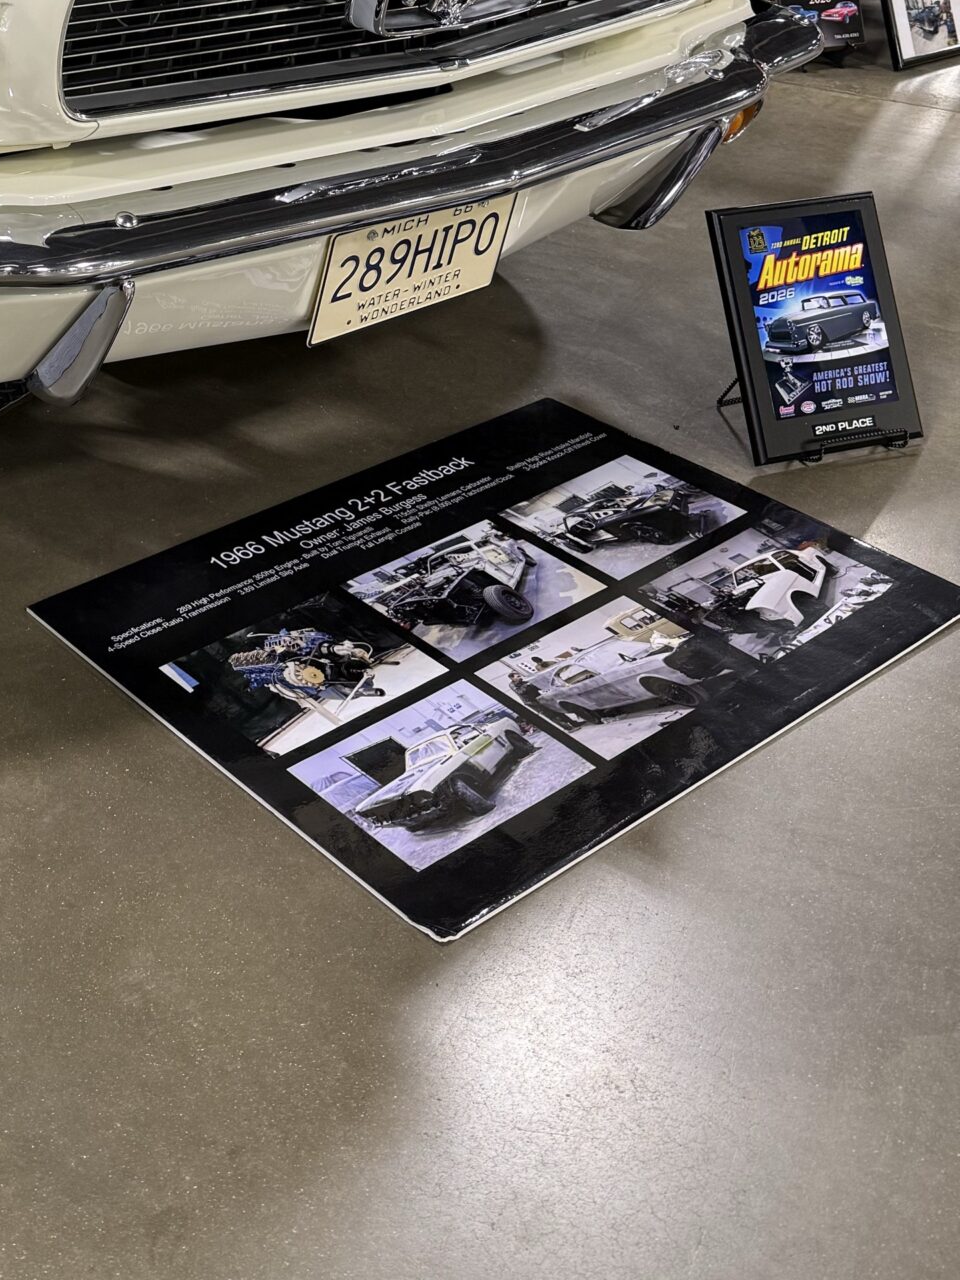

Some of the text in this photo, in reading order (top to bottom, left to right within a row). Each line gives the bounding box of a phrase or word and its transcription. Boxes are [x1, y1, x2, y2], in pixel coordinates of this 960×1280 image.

[381, 214, 430, 239] MICH
[783, 237, 802, 247] ANNUAL
[801, 226, 850, 251] DETROIT
[329, 211, 500, 304] 289HIPO
[756, 243, 864, 291] Autorama
[356, 270, 461, 312] WATER-WINTER
[359, 285, 451, 324] WONDERLAND
[759, 287, 796, 305] 2026
[812, 361, 888, 382] AMERICA'S GREATEST
[814, 381, 833, 393] HOT
[836, 377, 854, 390] ROD
[857, 370, 890, 386] SHOW!
[815, 417, 873, 435] 2ND PLACE
[210, 457, 475, 569] 1966 Mustang 2+2 Fastback
[299, 493, 428, 549] Owner: James Burgess
[359, 521, 422, 550] Full Length Console
[107, 634, 141, 652] 4-Speed
[139, 617, 184, 638] Close-Ratio
[181, 596, 232, 619] Transmission
[237, 585, 255, 596] 3.89
[252, 574, 281, 589] Limited
[292, 562, 310, 572] Axle
[320, 548, 339, 559] Dual
[335, 537, 366, 552] Trumpet
[363, 526, 392, 541] Exhaust
[110, 617, 165, 642] Specifications:
[176, 603, 193, 614] 289
[190, 597, 211, 608] High
[208, 578, 254, 600] Performance
[273, 558, 300, 572] Engine
[301, 549, 320, 560] Built
[325, 539, 345, 548] Tom
